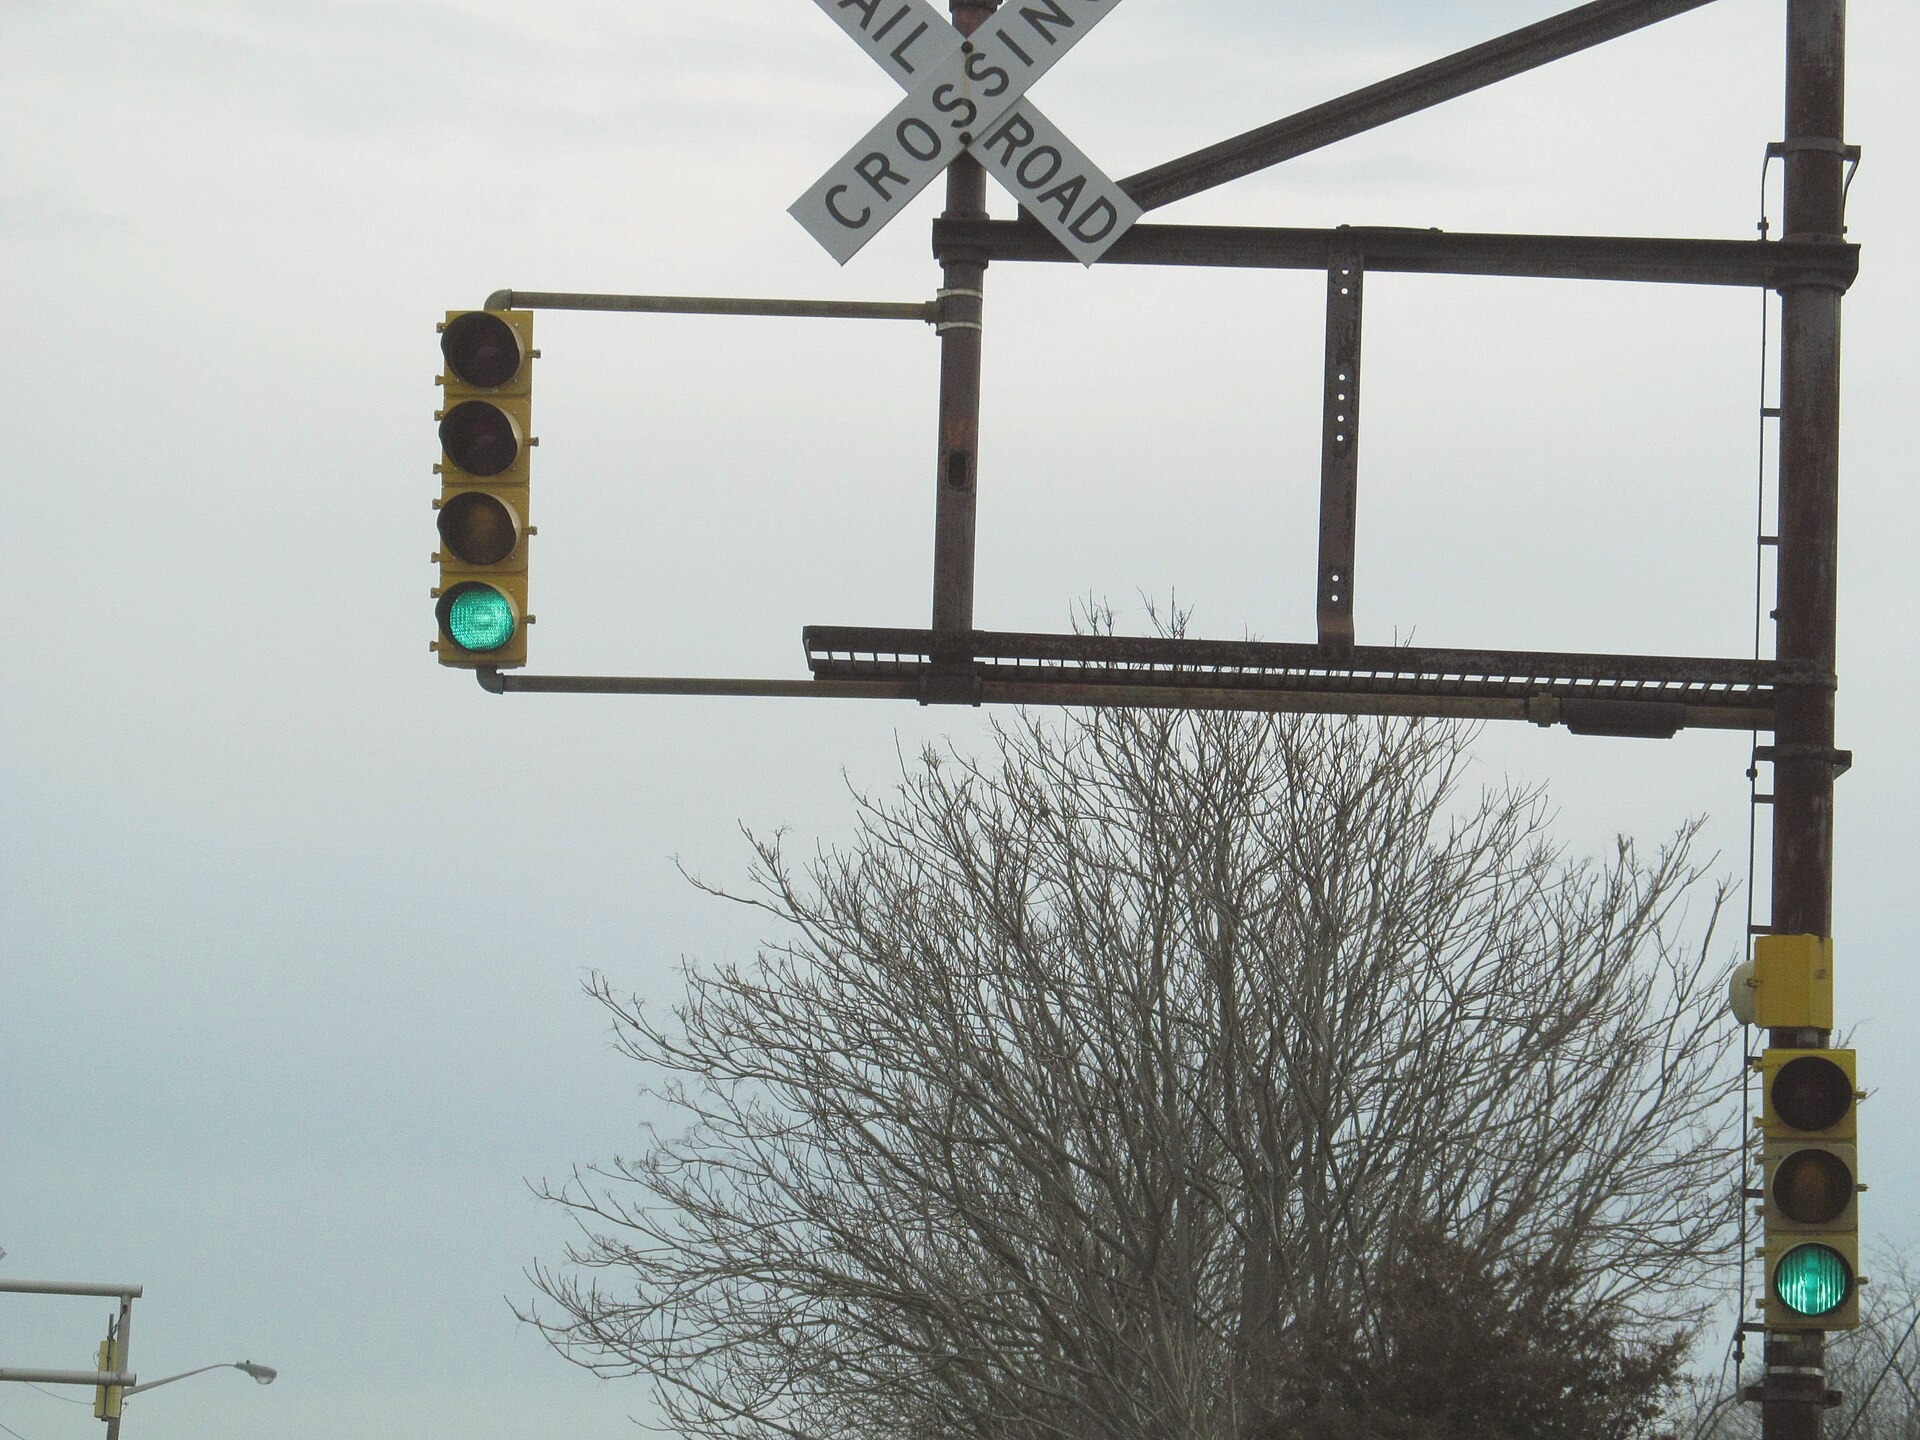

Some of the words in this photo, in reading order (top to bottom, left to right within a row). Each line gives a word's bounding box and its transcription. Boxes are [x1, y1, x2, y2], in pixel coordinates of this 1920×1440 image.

[824, 0, 1102, 230] CROSSIN
[837, 0, 929, 75] AIL
[983, 111, 1118, 244] ROAD
